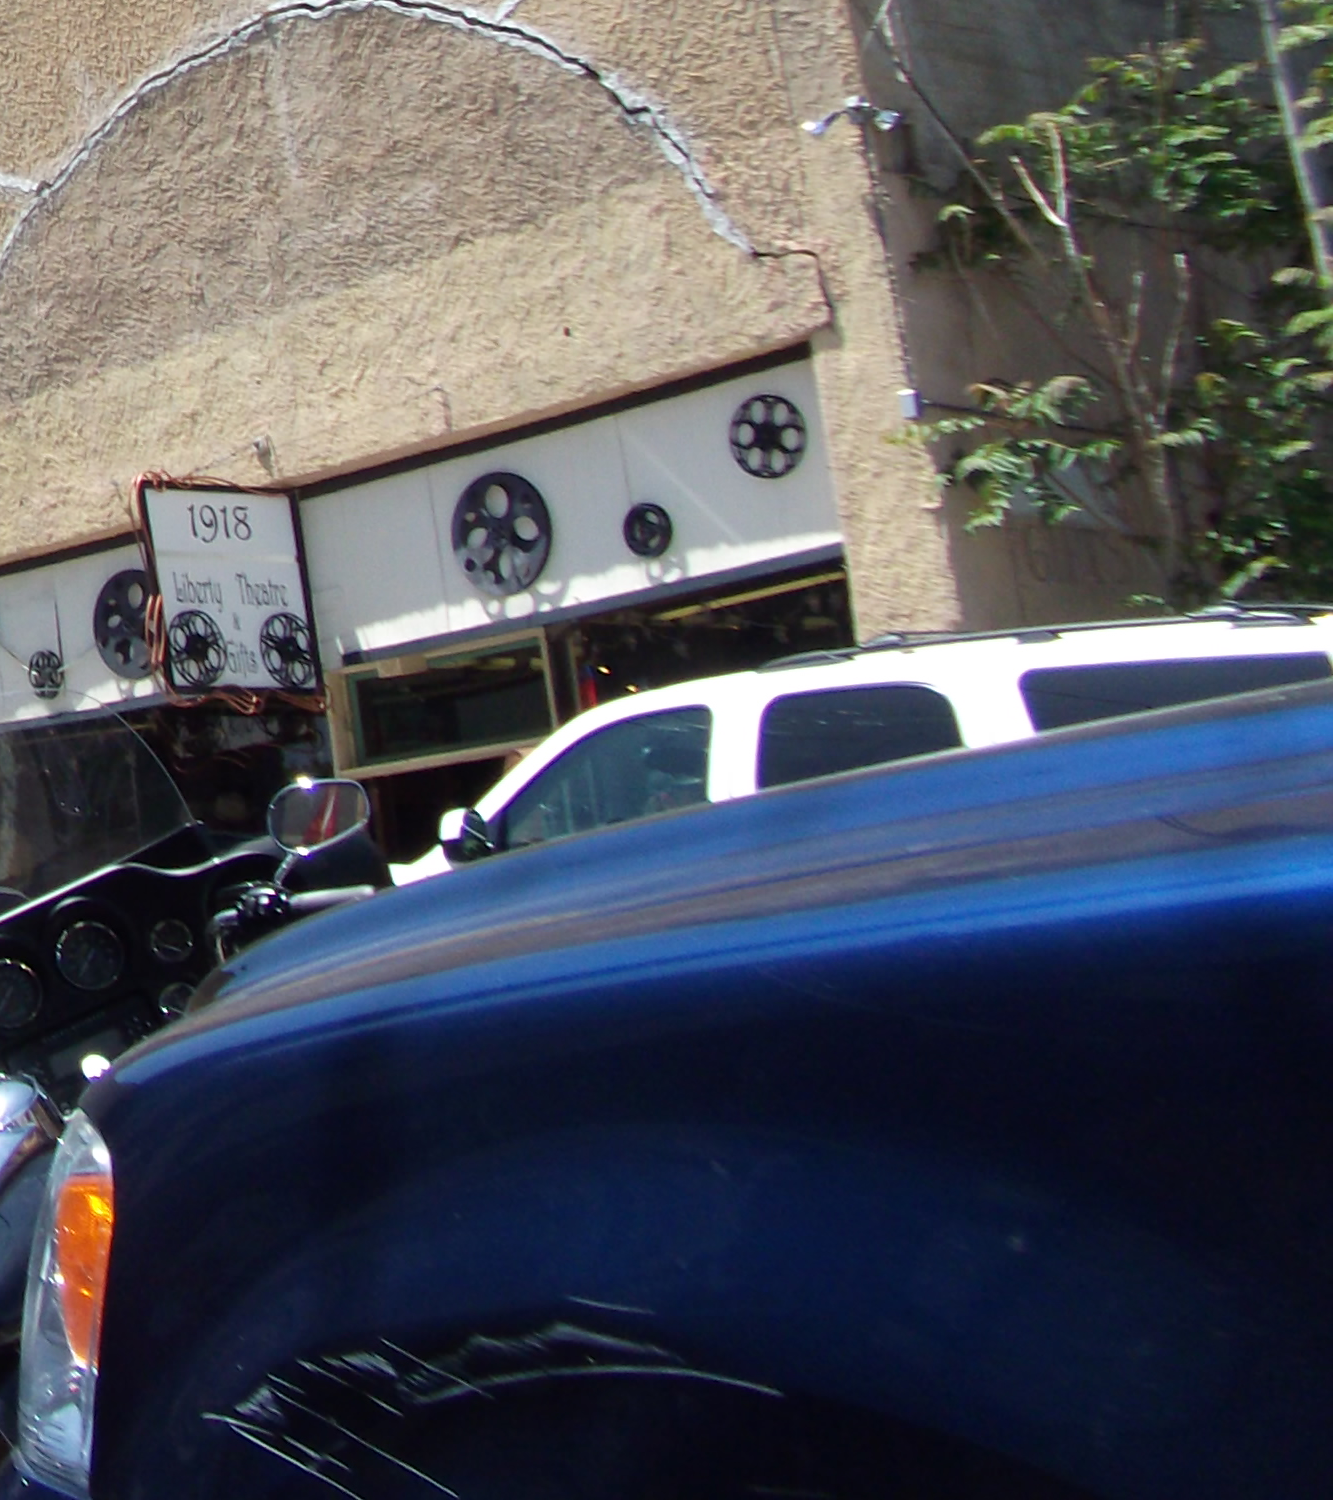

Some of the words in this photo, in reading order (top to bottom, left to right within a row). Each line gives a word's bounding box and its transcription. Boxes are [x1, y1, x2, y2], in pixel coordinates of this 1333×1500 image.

[187, 504, 252, 542] 1918
[172, 572, 223, 612] Liberty
[235, 573, 289, 608] Theatre
[226, 640, 258, 677] Gifts
